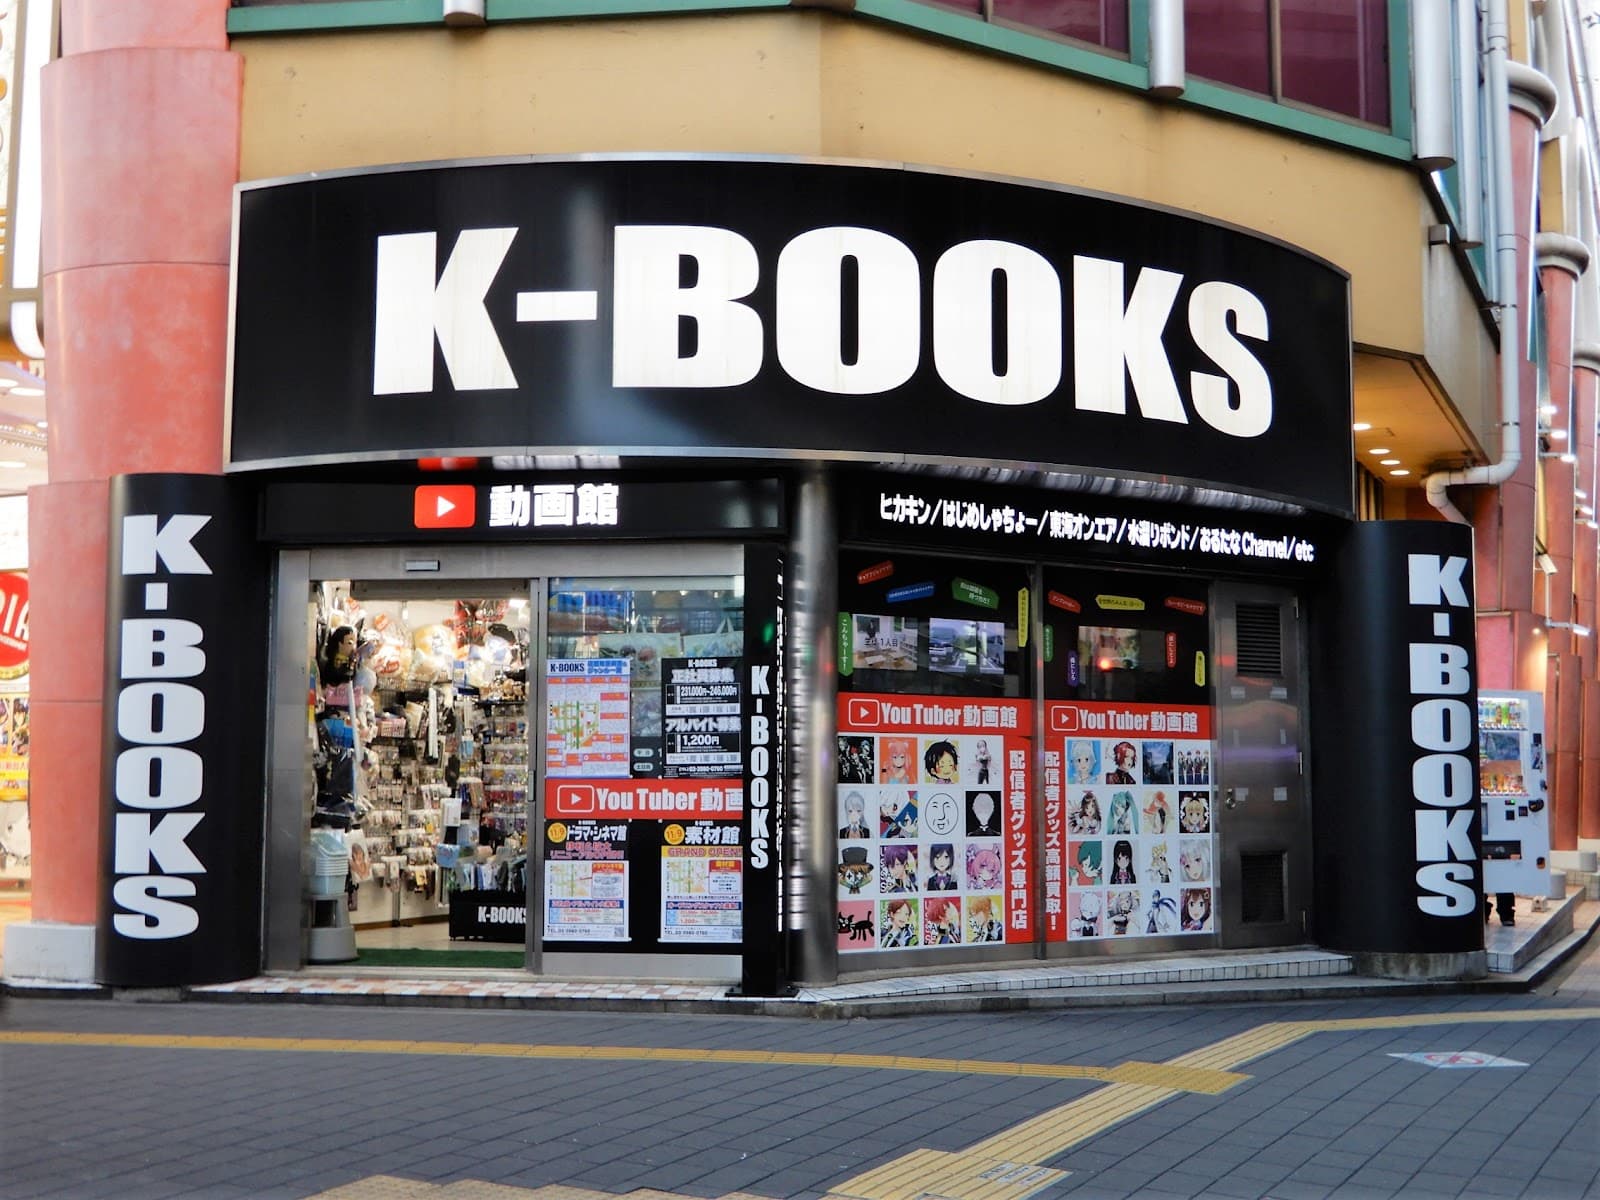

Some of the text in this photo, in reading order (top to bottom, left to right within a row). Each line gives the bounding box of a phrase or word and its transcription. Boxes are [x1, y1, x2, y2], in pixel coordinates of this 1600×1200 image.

[374, 225, 1273, 438] K-BOOKS
[489, 483, 619, 527] 動画館
[113, 514, 213, 939] K-BOOKS
[751, 665, 770, 869] K-BOOKS
[963, 705, 1018, 728] 動画館
[1151, 712, 1198, 733] 動画館
[1407, 554, 1476, 917] K-BOOKS
[685, 826, 740, 845] 素材館
[1009, 750, 1028, 930] 配信者グッズ専門店
